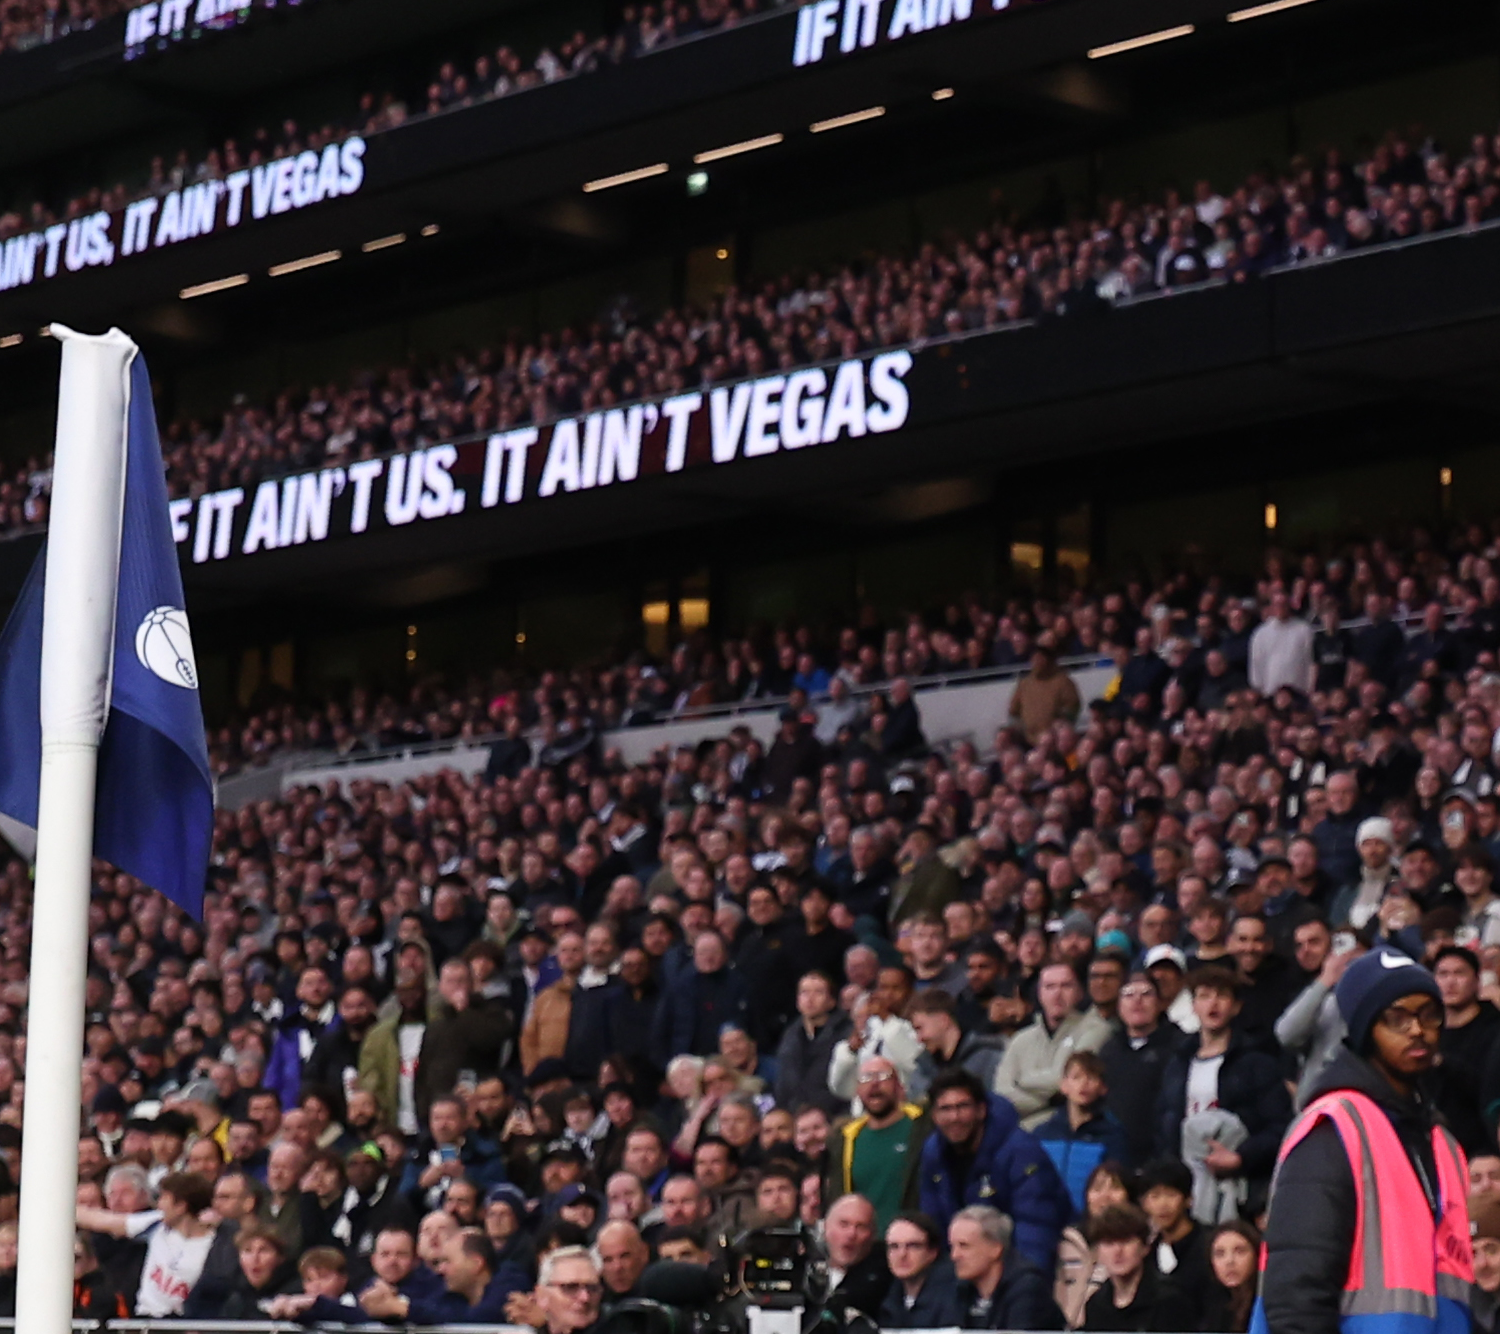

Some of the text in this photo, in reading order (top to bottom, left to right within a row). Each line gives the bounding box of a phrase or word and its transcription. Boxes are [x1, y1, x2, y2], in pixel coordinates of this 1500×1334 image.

[793, 1, 838, 66] IF
[121, 197, 158, 256] IT
[155, 169, 249, 247] AIN'T
[249, 136, 366, 220] VEGAS
[193, 488, 244, 563] IT
[243, 459, 383, 554] AIN'T
[481, 427, 539, 508] IT
[539, 394, 702, 497] AIN'T
[710, 351, 913, 463] VEGAS
